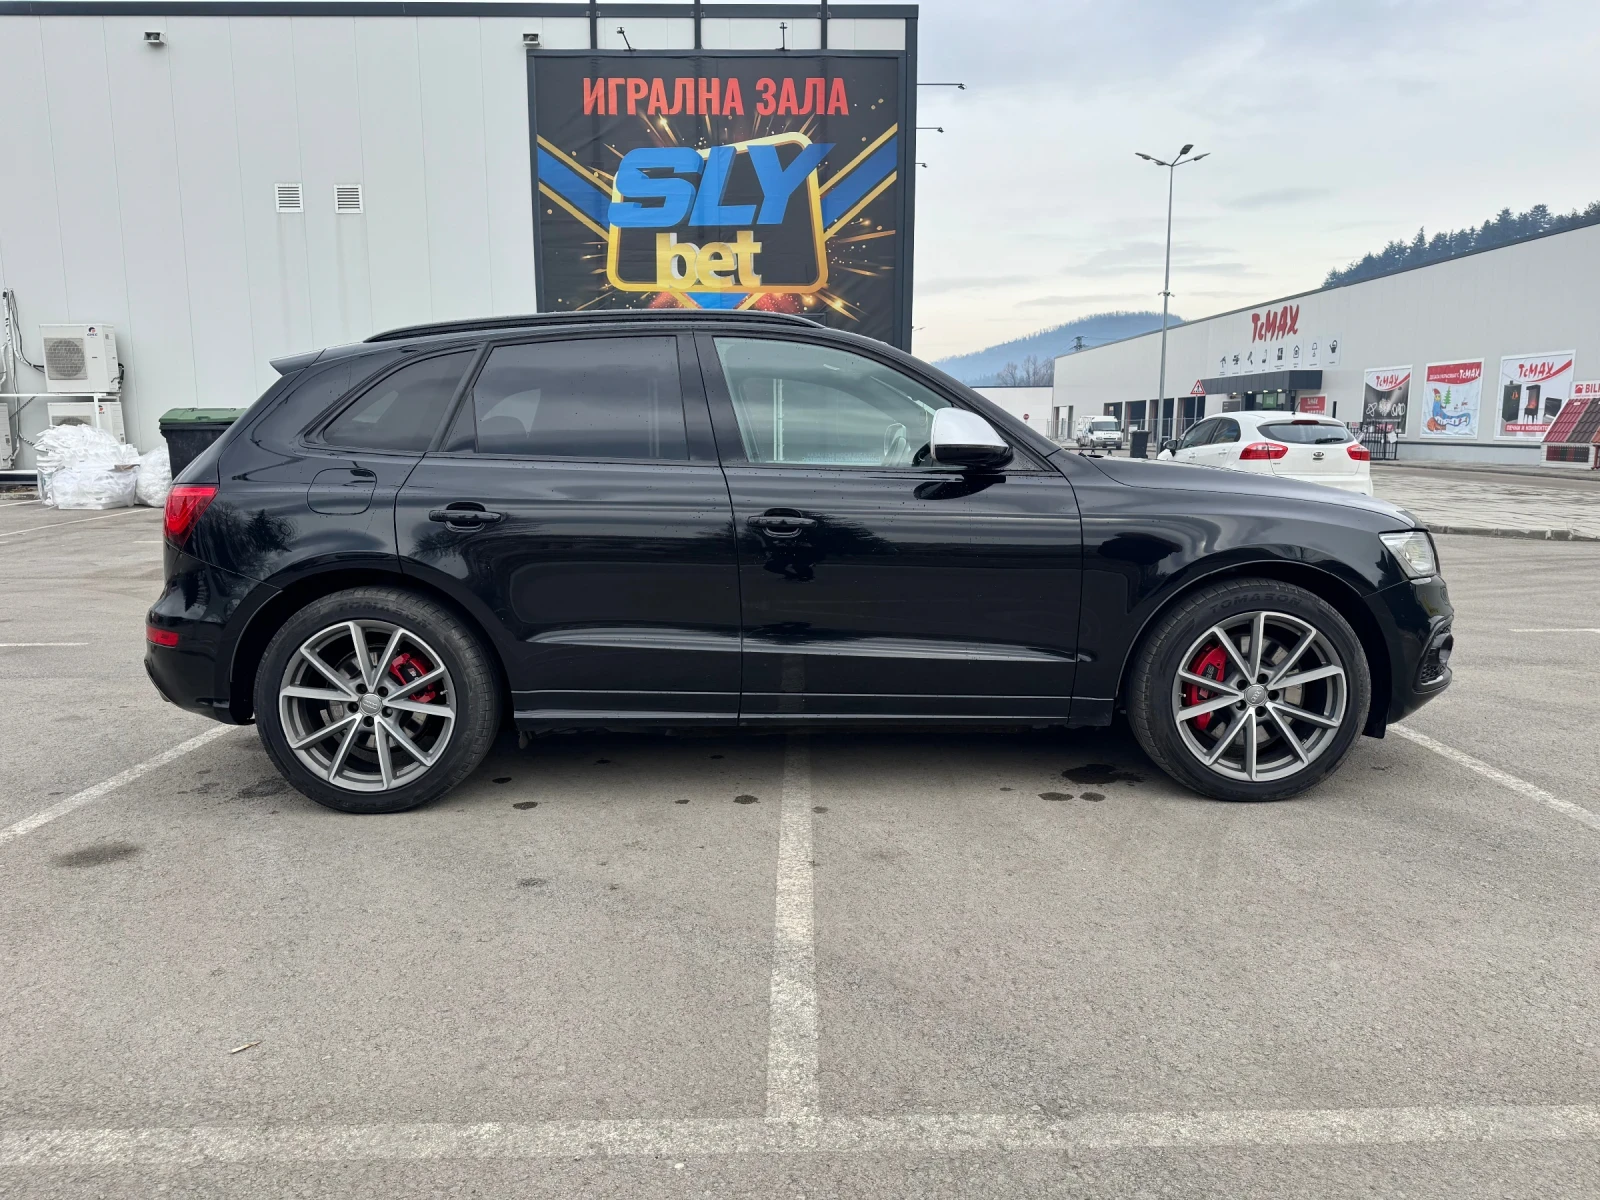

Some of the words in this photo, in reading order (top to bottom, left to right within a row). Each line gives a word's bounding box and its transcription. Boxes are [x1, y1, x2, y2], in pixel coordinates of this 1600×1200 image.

[583, 77, 744, 116] ИГРАЛНА
[756, 77, 850, 116] ЗАЛА
[607, 143, 836, 228] SLY
[656, 230, 762, 290] bet
[1210, 592, 1302, 613] TOMASON
